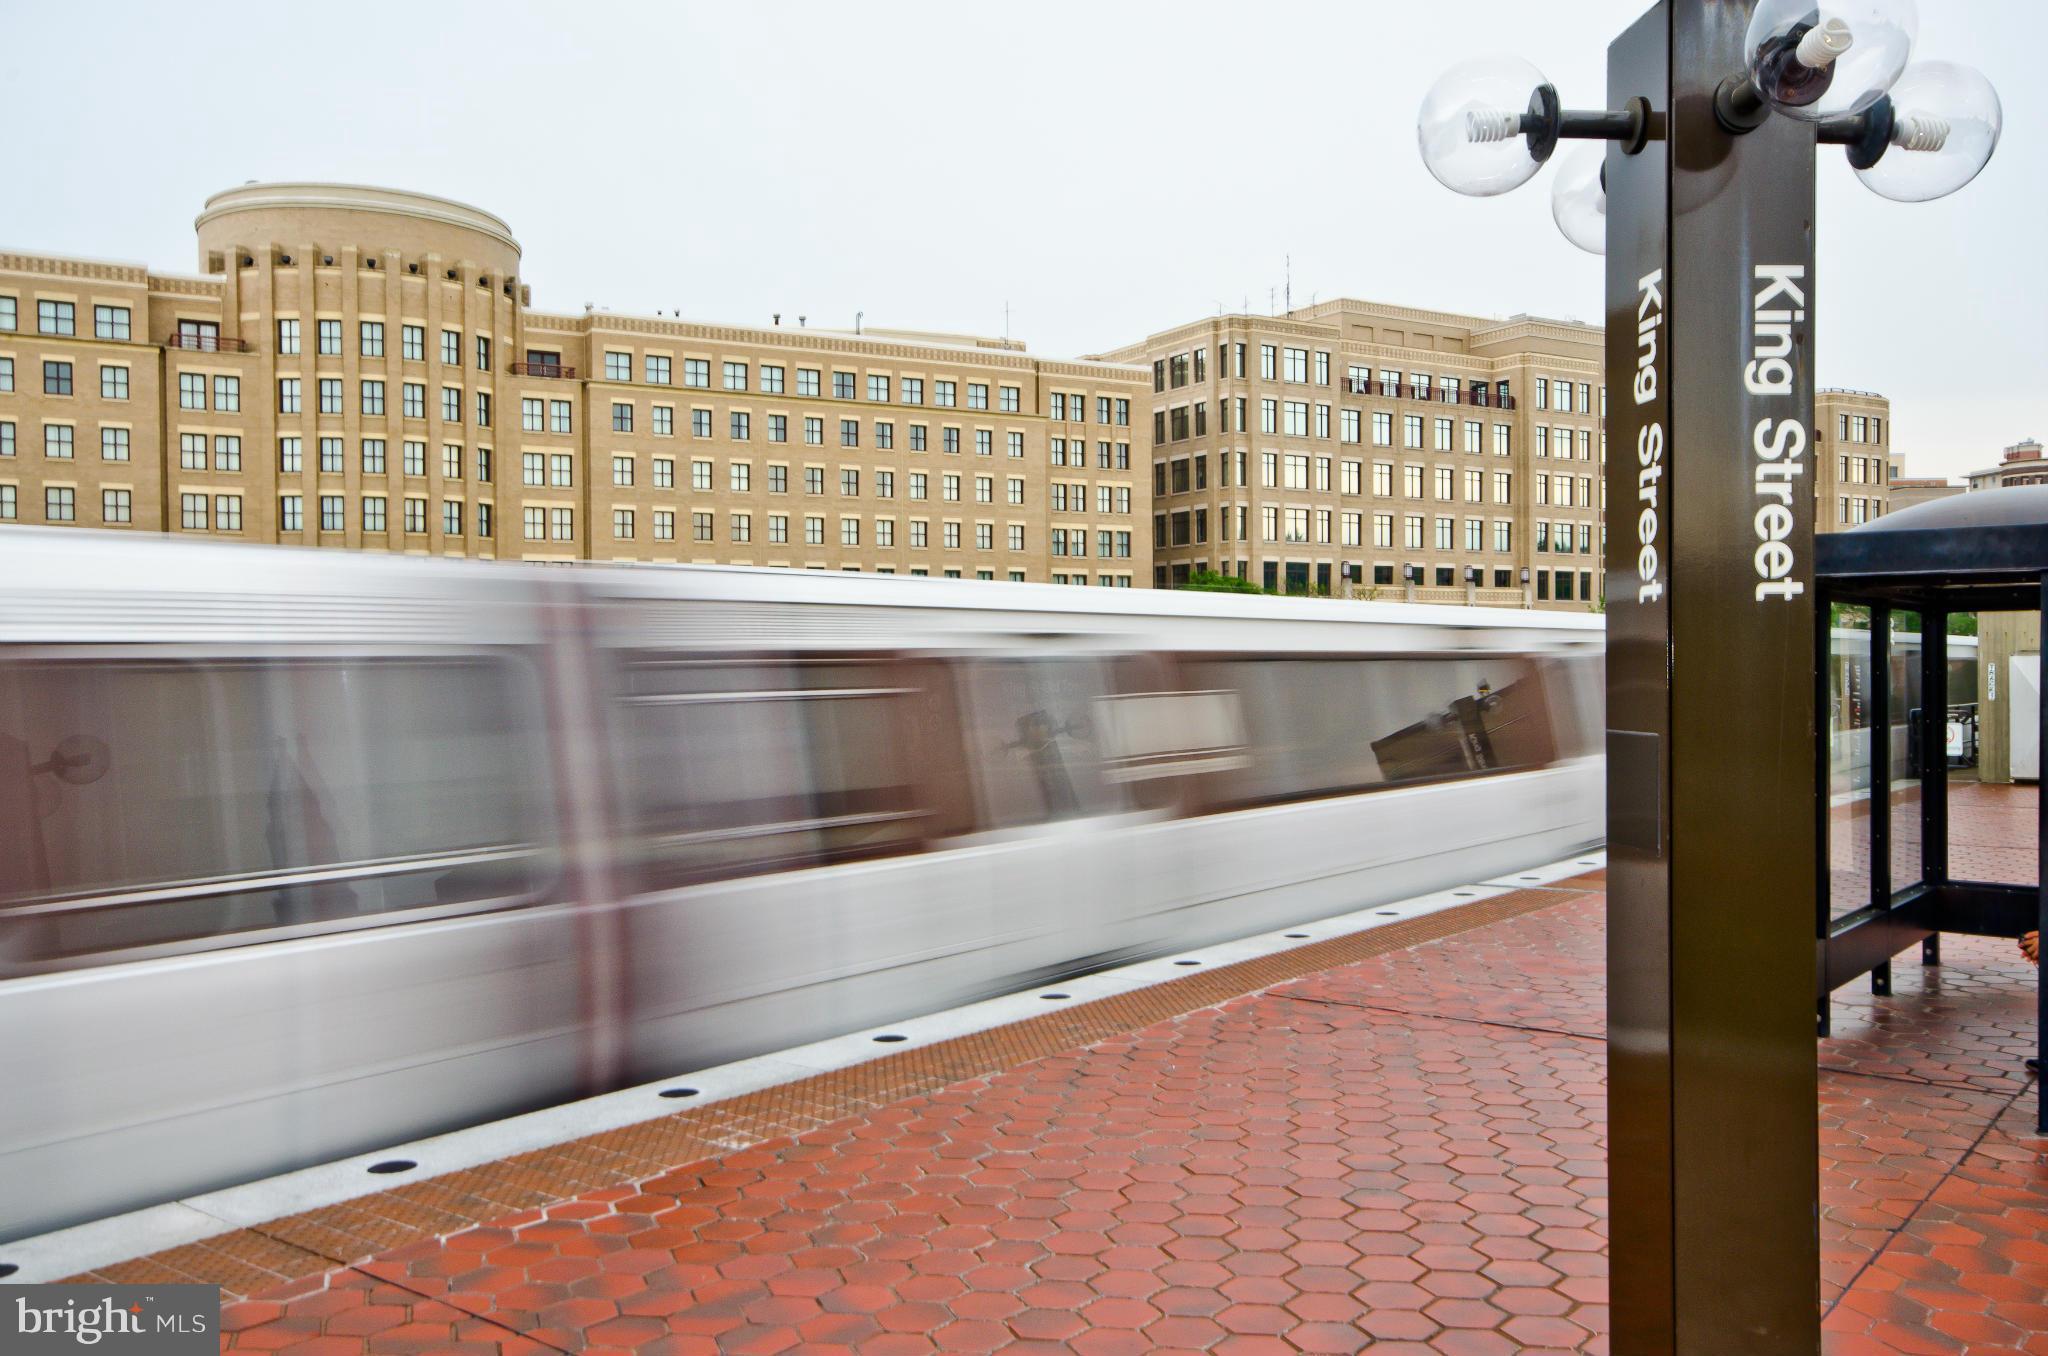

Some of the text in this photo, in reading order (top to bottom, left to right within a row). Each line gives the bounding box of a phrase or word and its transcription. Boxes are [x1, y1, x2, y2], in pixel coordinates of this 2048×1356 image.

[1634, 268, 1663, 604] King Street
[1744, 264, 1806, 602] King Street
